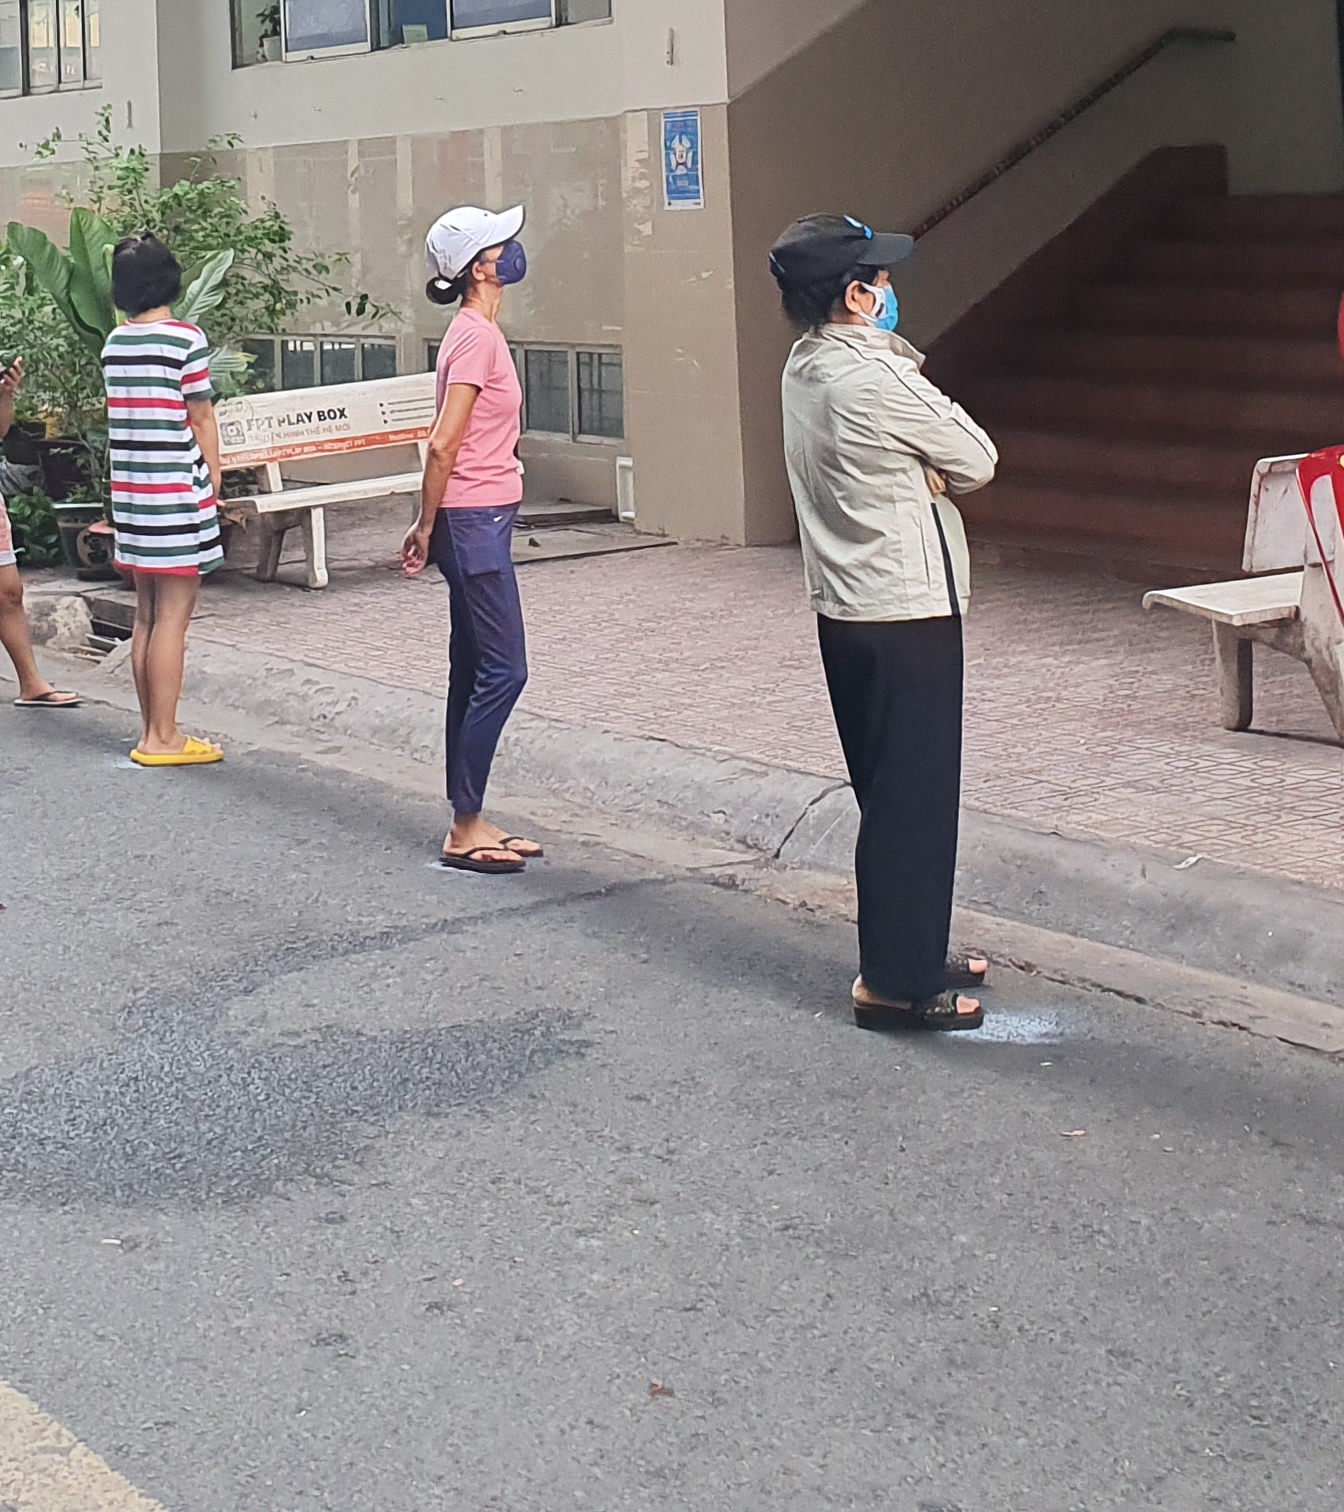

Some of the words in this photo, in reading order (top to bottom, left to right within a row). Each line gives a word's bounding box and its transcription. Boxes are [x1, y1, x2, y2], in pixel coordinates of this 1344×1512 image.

[246, 416, 274, 432] FPT
[276, 411, 313, 428] PLAY
[316, 407, 349, 422] BOX
